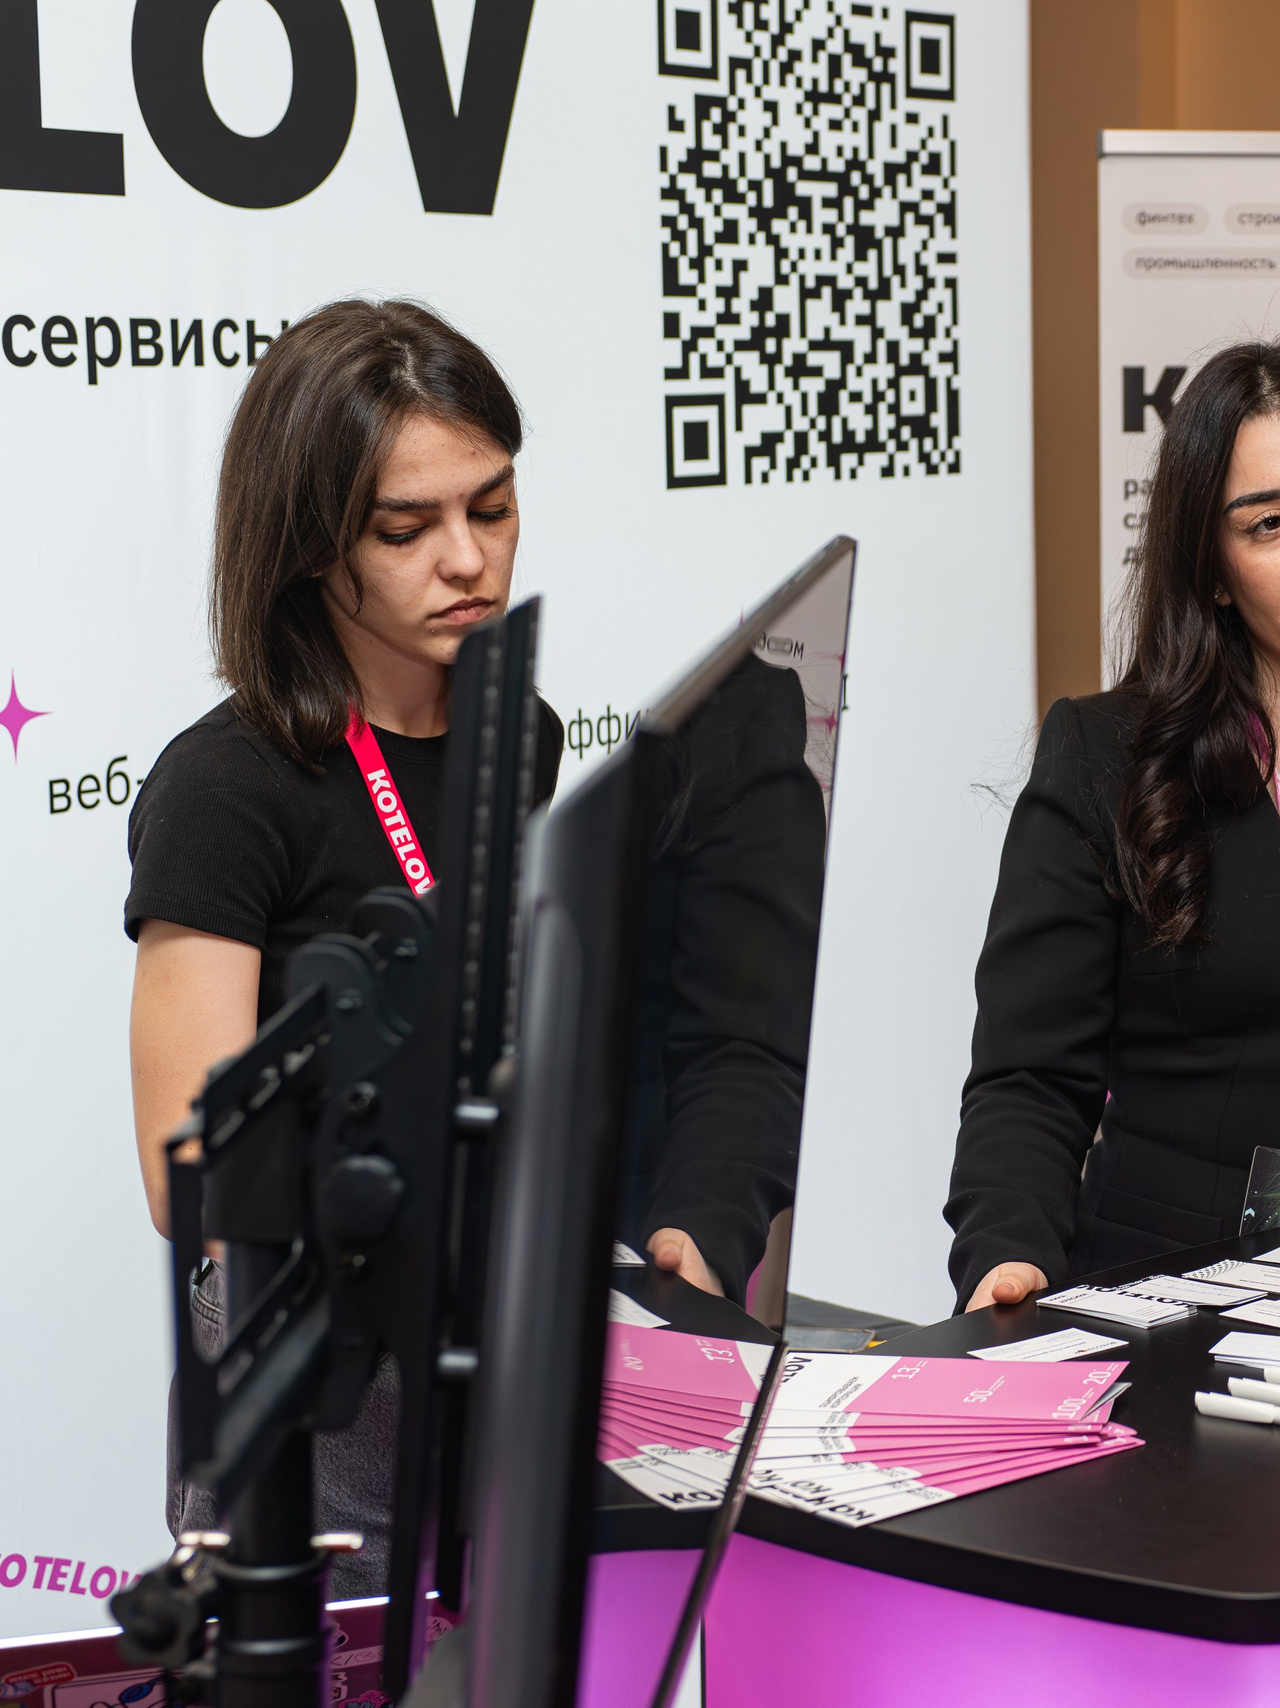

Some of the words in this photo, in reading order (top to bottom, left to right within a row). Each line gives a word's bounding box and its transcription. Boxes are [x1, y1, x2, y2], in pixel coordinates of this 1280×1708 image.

[1135, 210, 1195, 227] финтех
[1135, 256, 1278, 272] промышленность
[367, 769, 436, 895] KOTELOV
